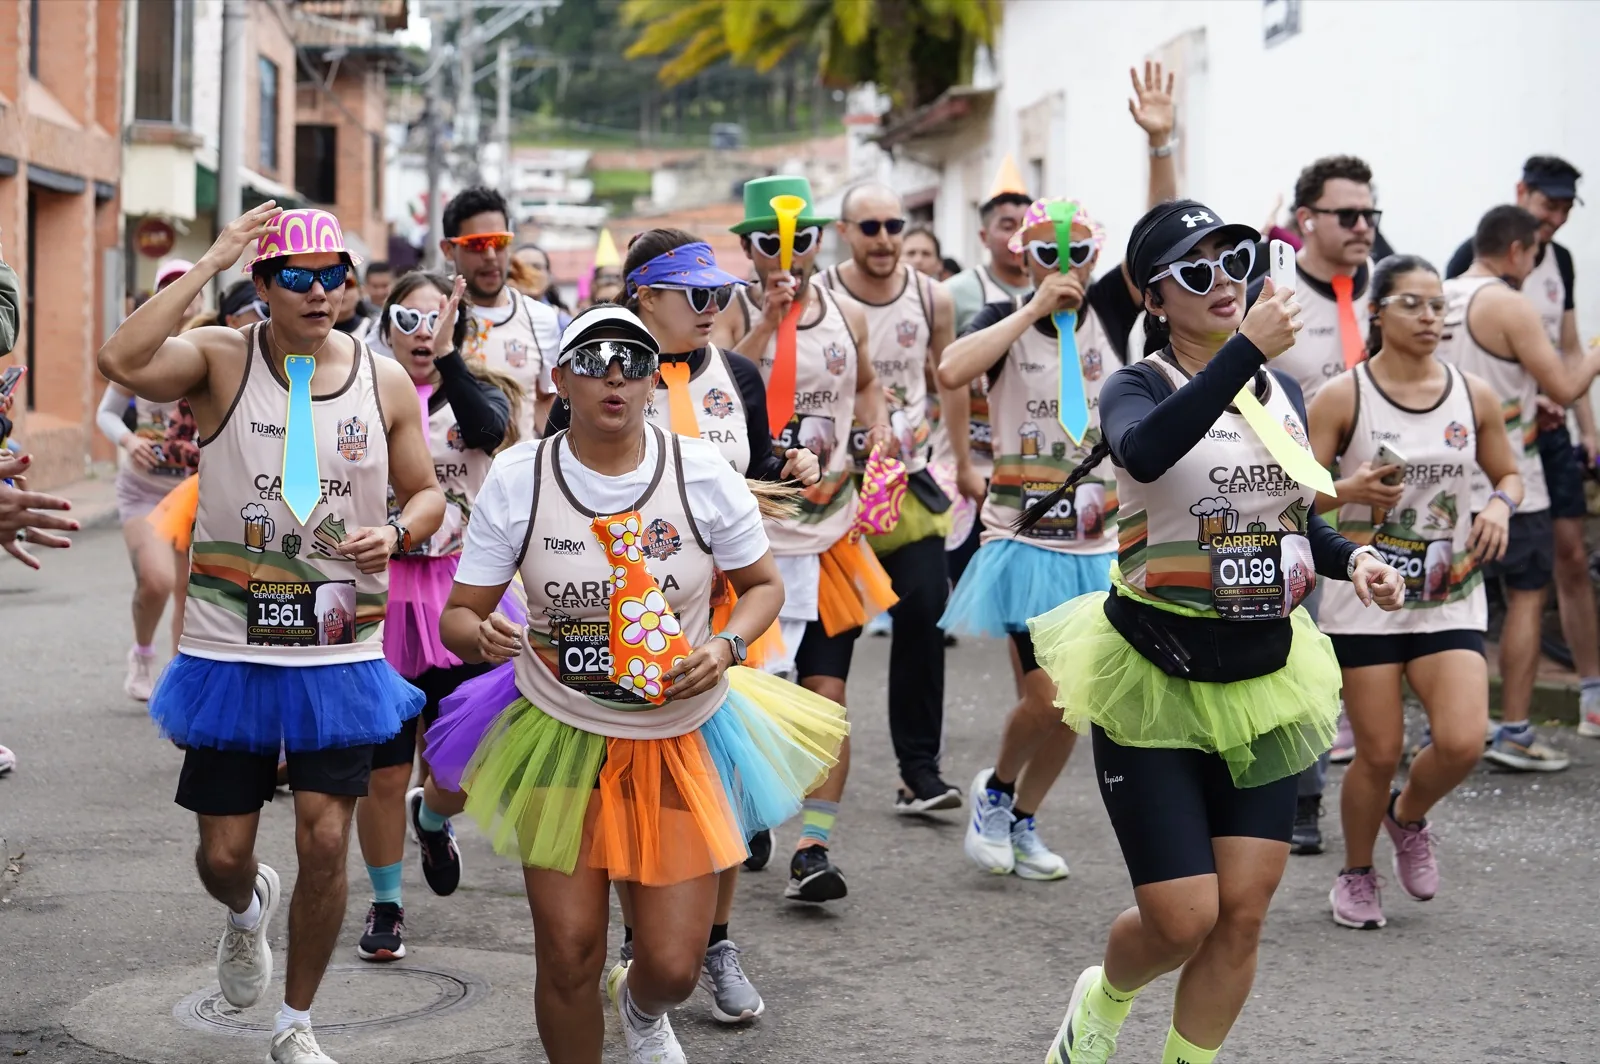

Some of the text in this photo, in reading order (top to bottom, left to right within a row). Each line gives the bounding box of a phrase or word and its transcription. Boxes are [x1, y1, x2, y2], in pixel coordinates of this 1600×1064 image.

[1204, 429, 1241, 440] UERKA
[1208, 464, 1294, 485] CARR
[1405, 464, 1464, 479] RRERA
[254, 473, 352, 497] CAERA
[1217, 481, 1300, 494] CERVECERA
[1212, 534, 1277, 548] CARRERA
[1217, 546, 1262, 554] CERVECERA
[1220, 557, 1275, 586] 0189
[250, 583, 311, 595] CARRERA
[544, 574, 680, 600] CARA
[253, 592, 295, 600] CERVECERA
[552, 597, 610, 609] CERVEC
[258, 603, 304, 627] 1361
[561, 624, 610, 636] CARRE
[565, 646, 610, 673] 028
